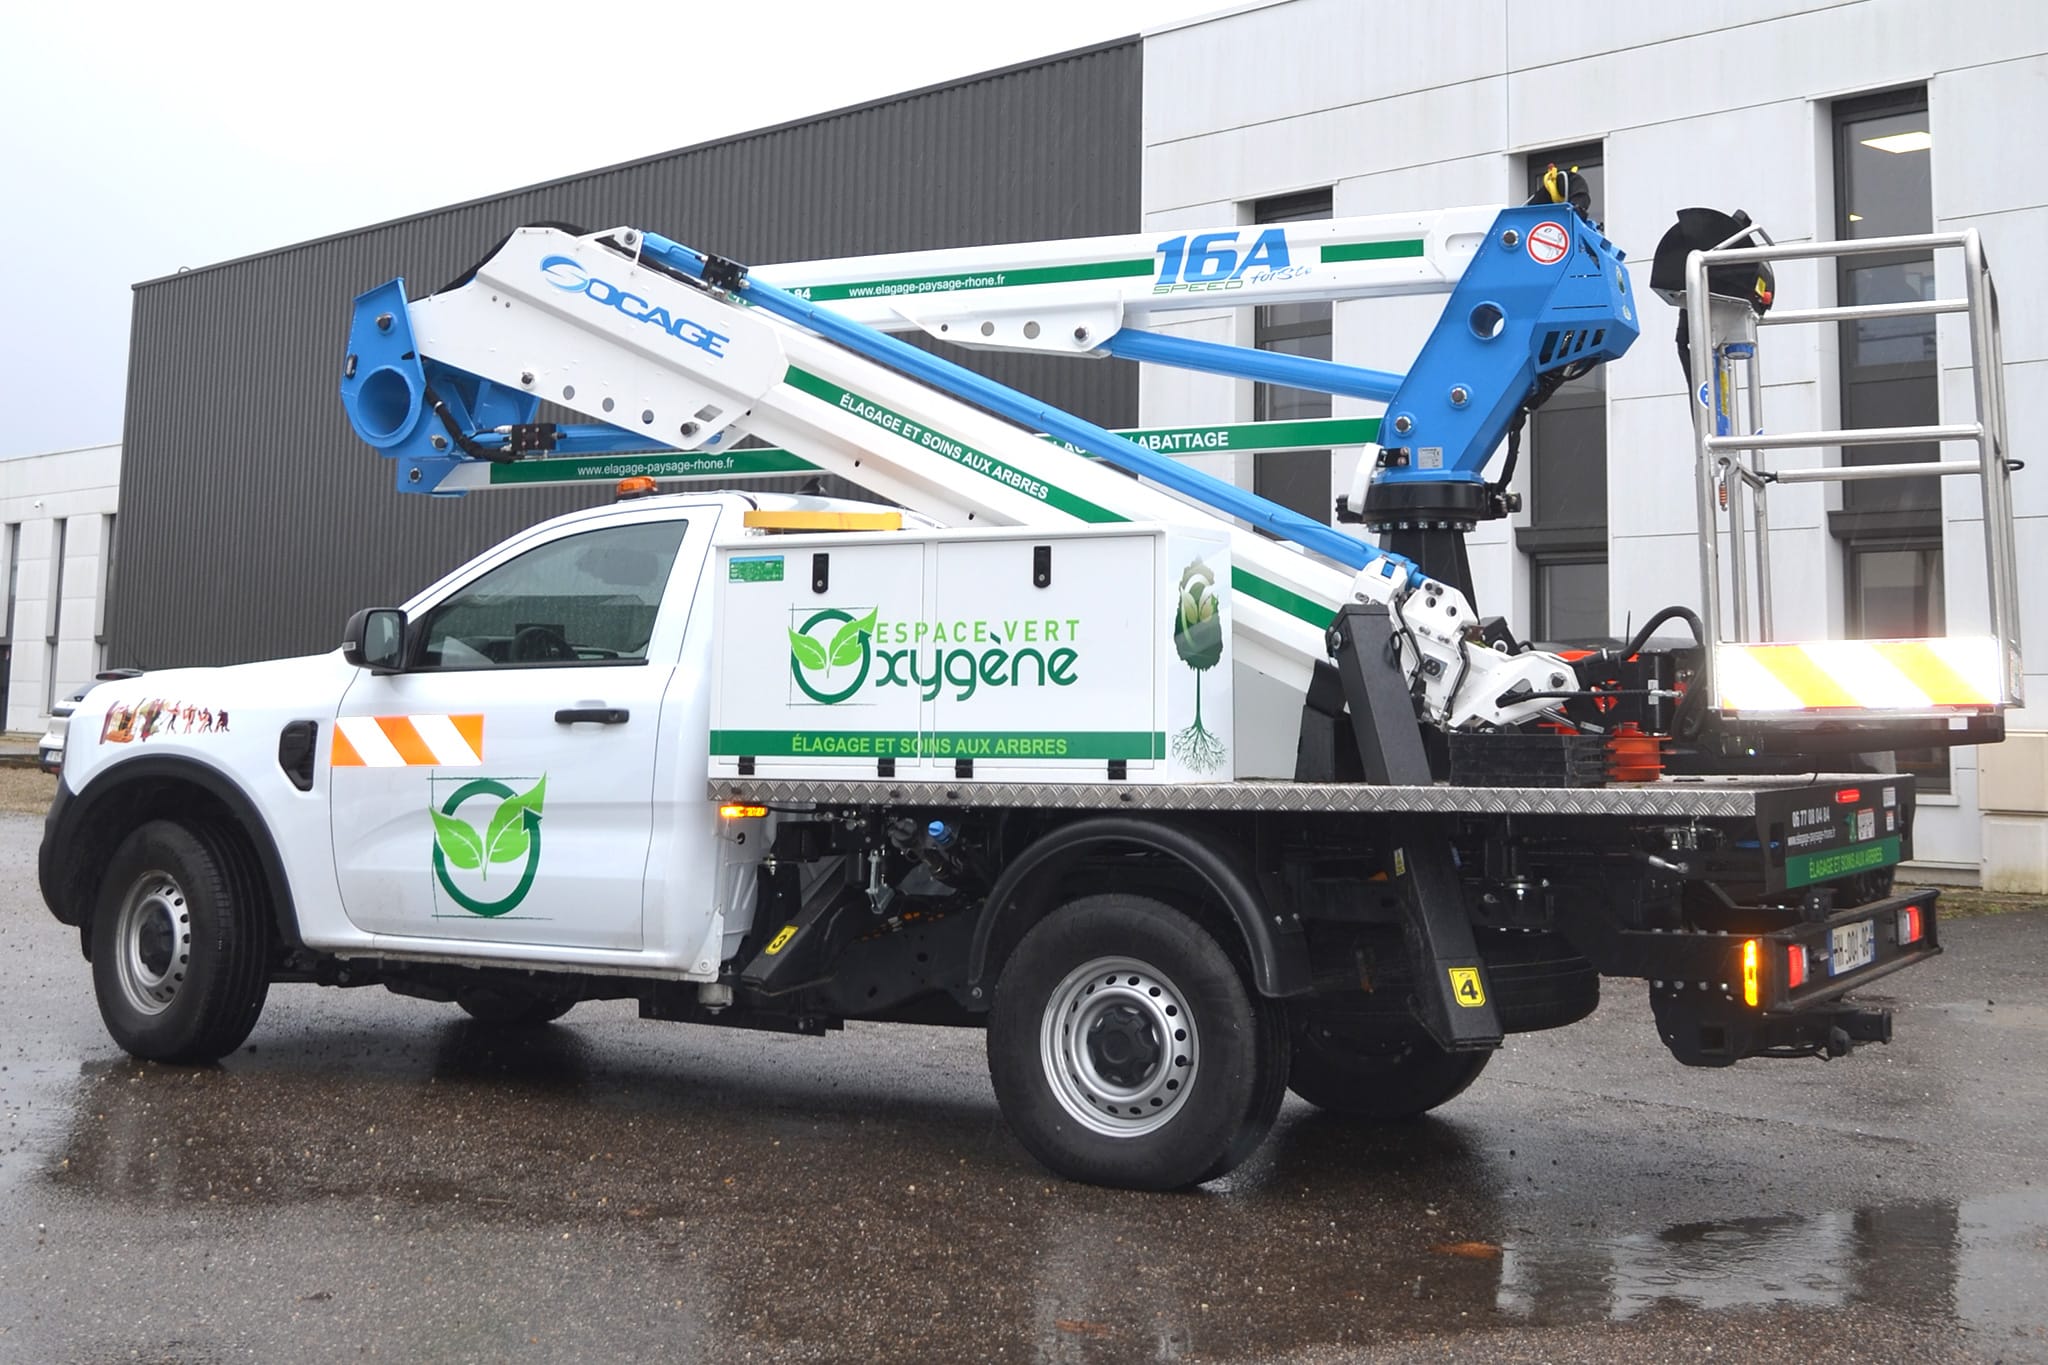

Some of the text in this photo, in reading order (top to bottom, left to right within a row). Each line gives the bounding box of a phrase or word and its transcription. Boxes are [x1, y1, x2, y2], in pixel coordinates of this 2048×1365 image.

[1155, 228, 1290, 285] 16A
[849, 274, 1006, 297] www.elagage-paysage-rhone.fr
[1152, 280, 1243, 294] SPEED
[540, 254, 730, 359] SOCAGE
[839, 393, 1049, 500] ÉLAGAGE ET SOINS AUX ARBRES
[1137, 431, 1229, 450] ABATTAGE
[577, 457, 734, 476] www.elagage-paysage-rhone.fr
[876, 619, 1080, 643] ESPACE VERT
[792, 734, 1067, 754] ÉLAGAGE ET SOINS AUX ARBRES
[772, 934, 788, 949] 3
[1460, 979, 1478, 1000] 4
